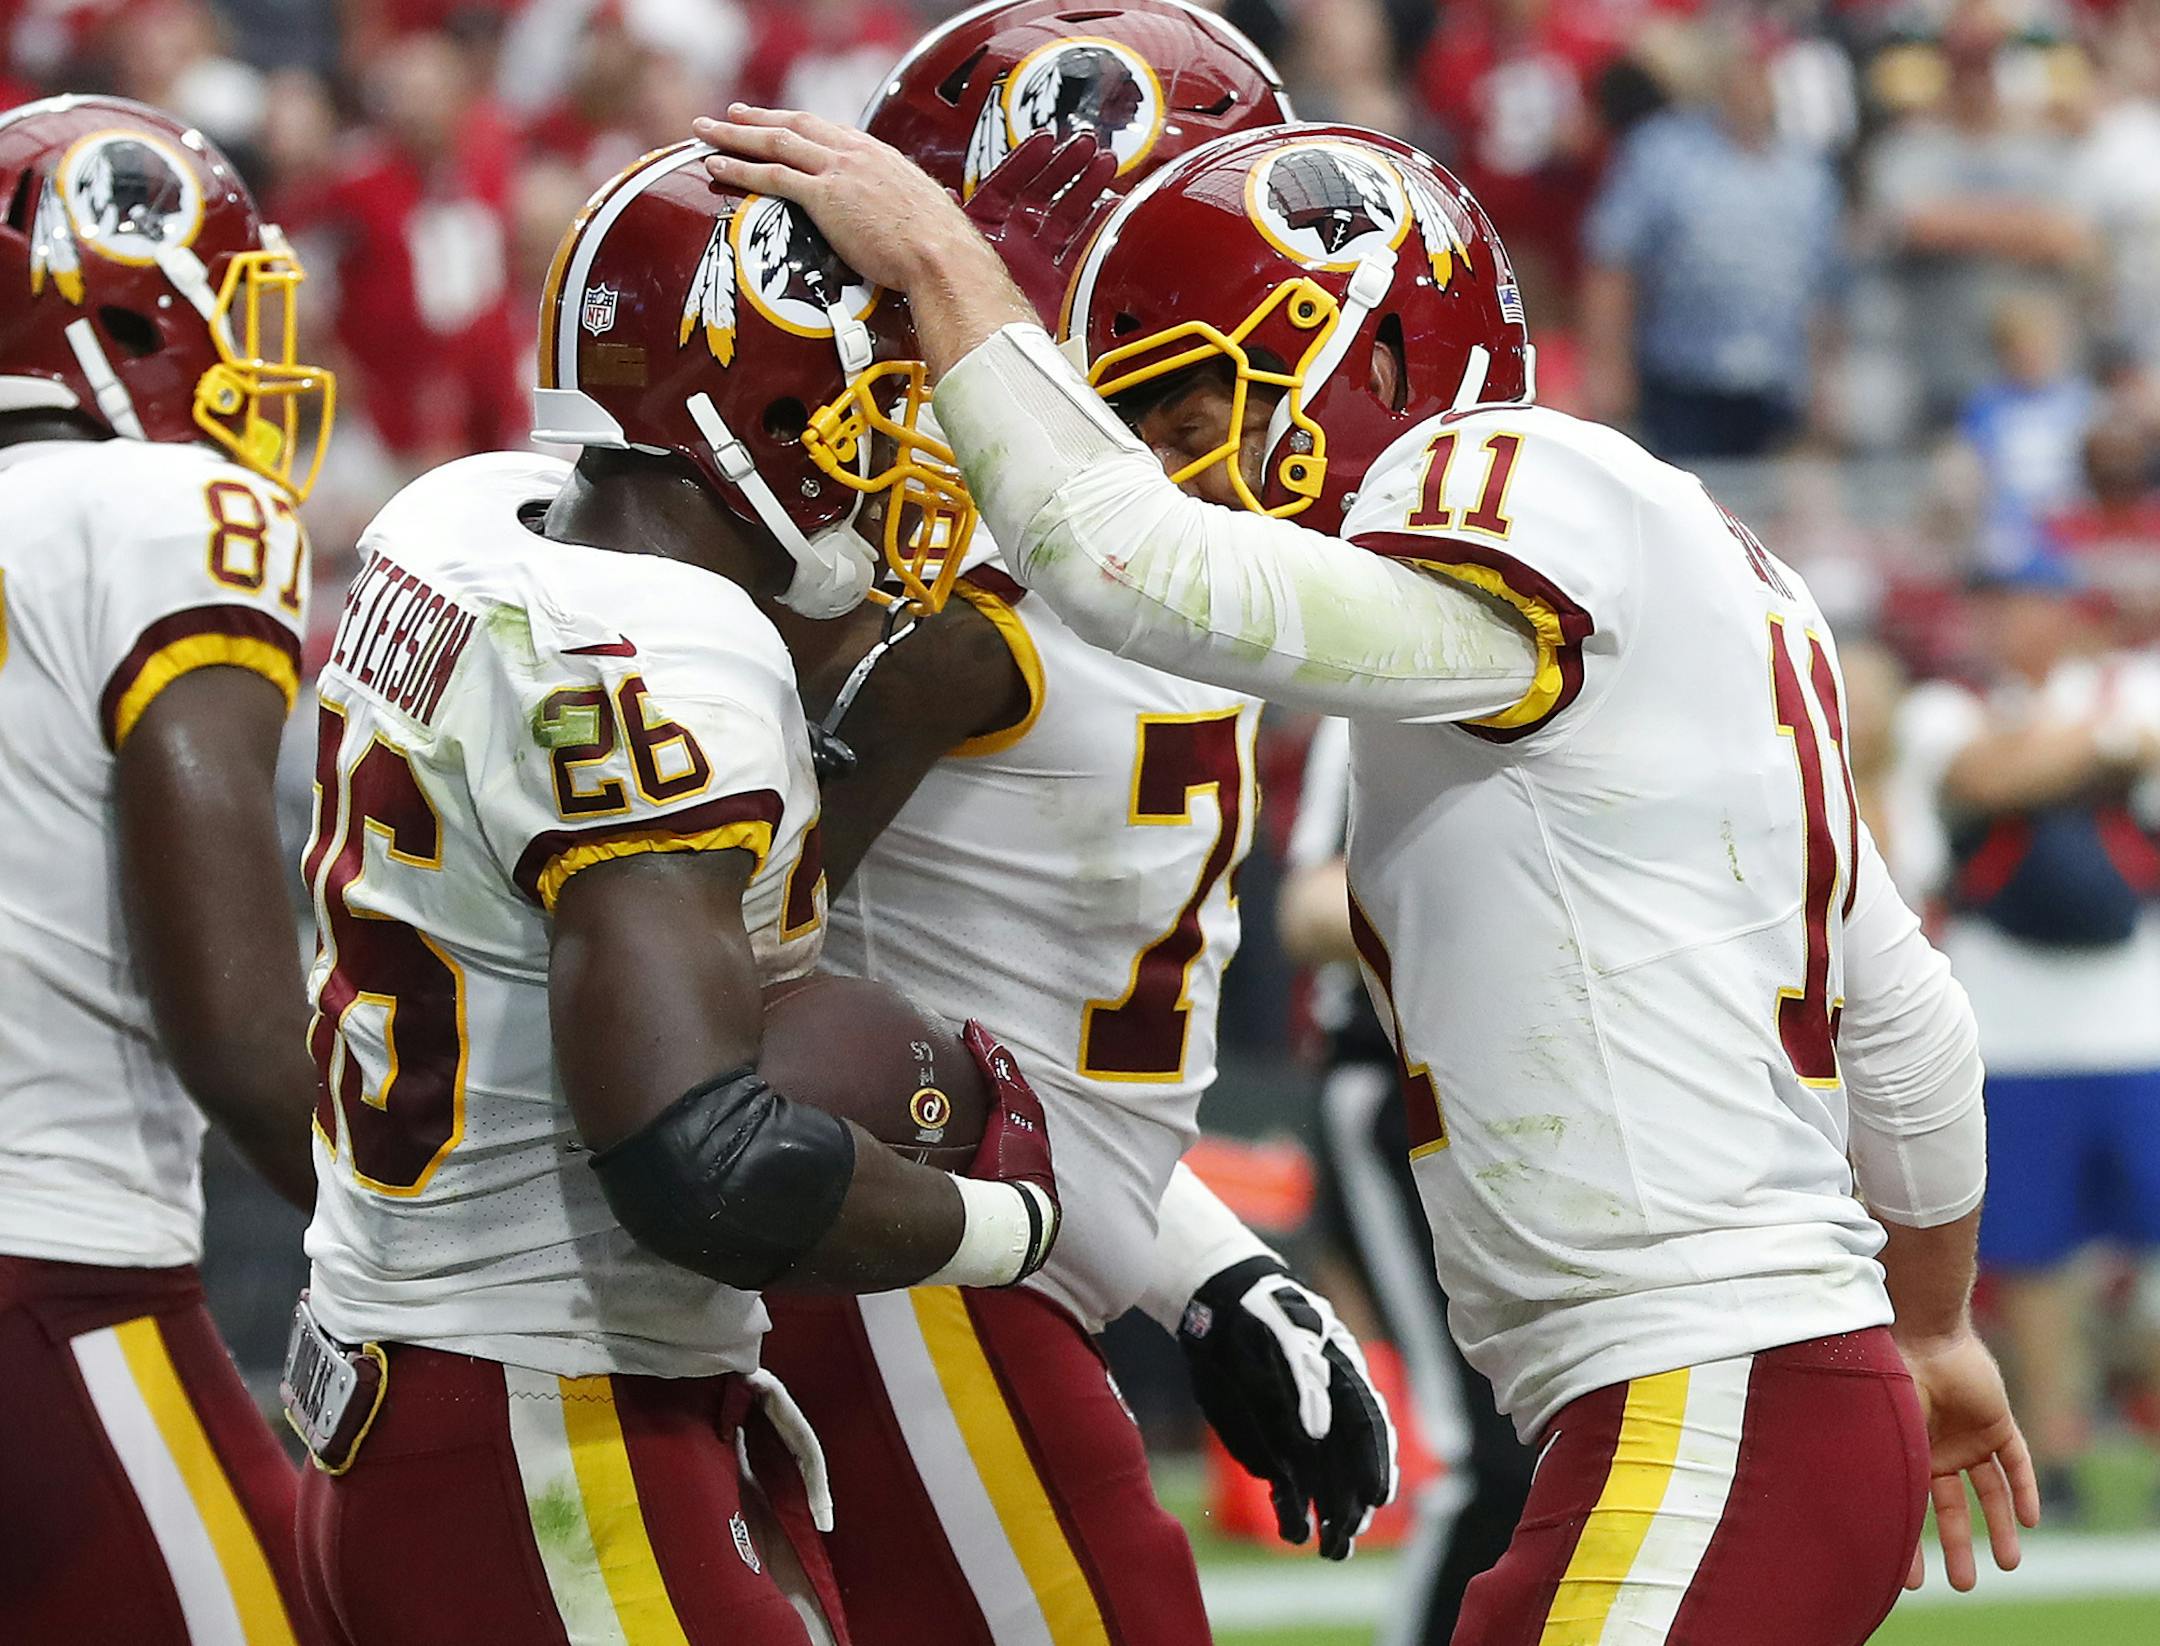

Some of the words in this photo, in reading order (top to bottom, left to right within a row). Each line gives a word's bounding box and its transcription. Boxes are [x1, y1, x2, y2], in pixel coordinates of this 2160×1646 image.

[1404, 429, 1526, 541] 11
[540, 671, 715, 822] 26
[1766, 612, 1859, 1090] 11
